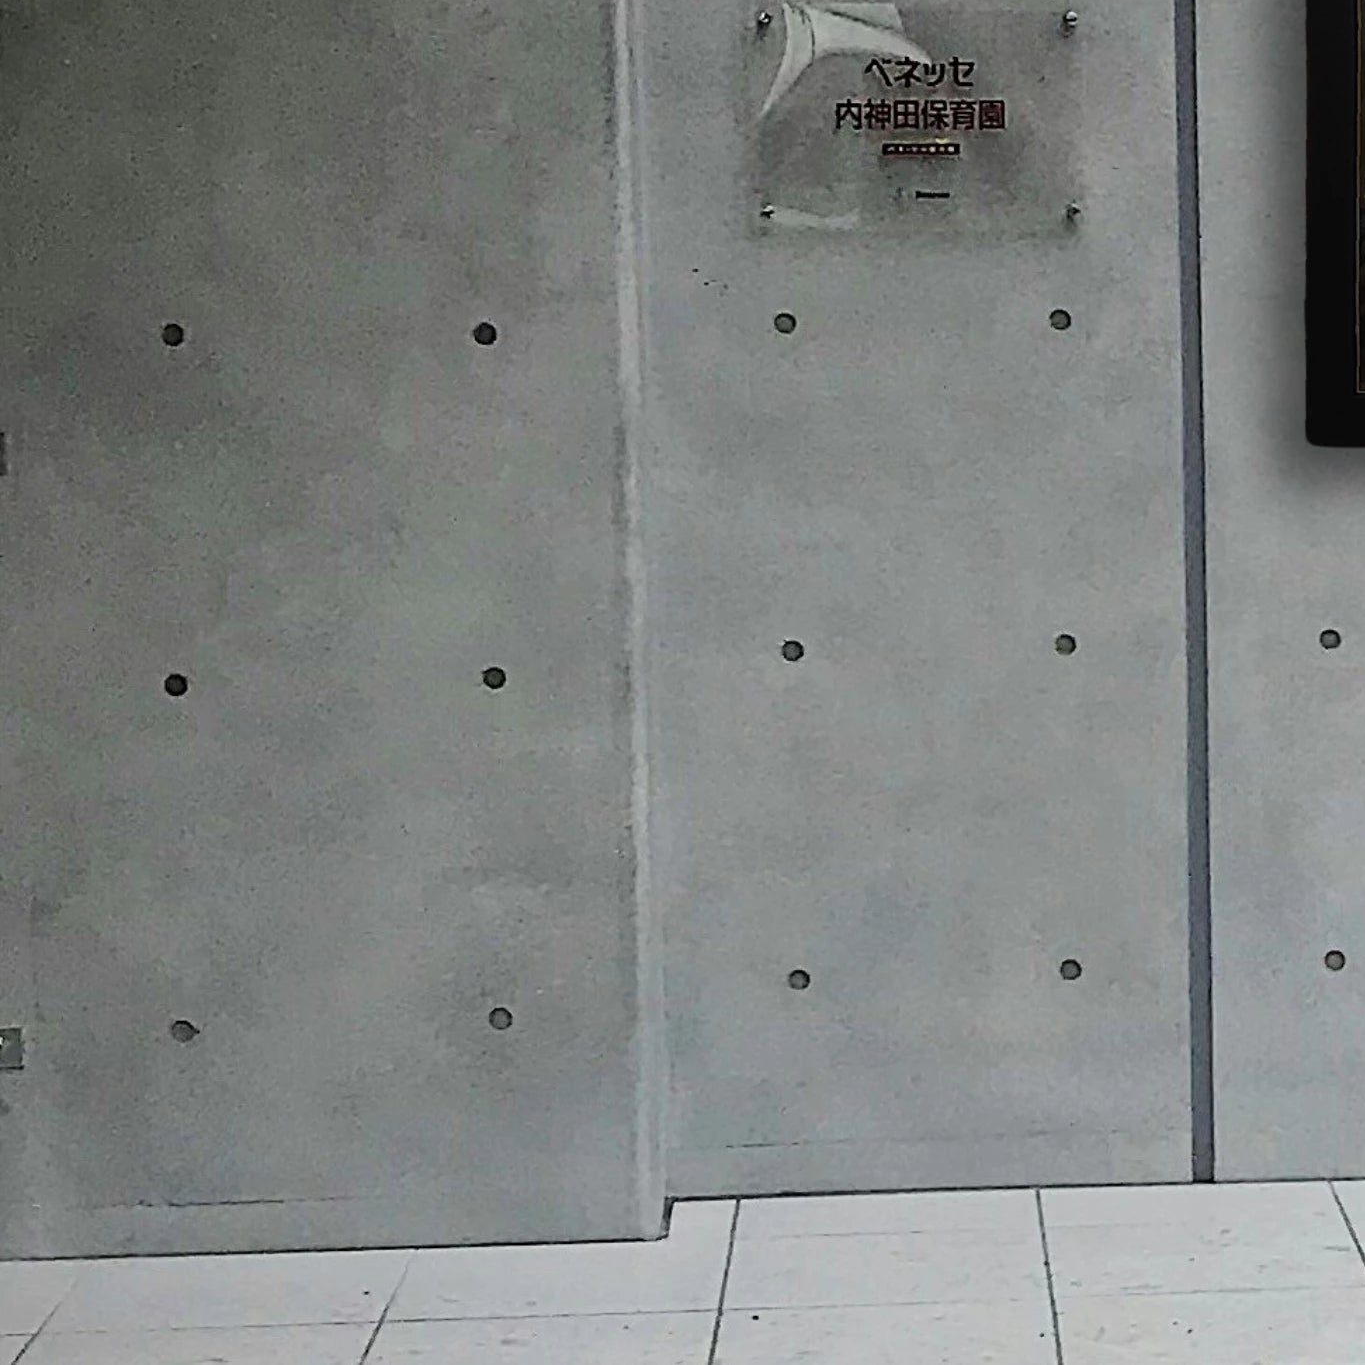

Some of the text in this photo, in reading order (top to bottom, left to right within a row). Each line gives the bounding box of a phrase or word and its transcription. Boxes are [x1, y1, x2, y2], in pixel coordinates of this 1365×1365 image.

[864, 56, 976, 87] ベネッセ
[834, 98, 1006, 131] 内神田保育園
